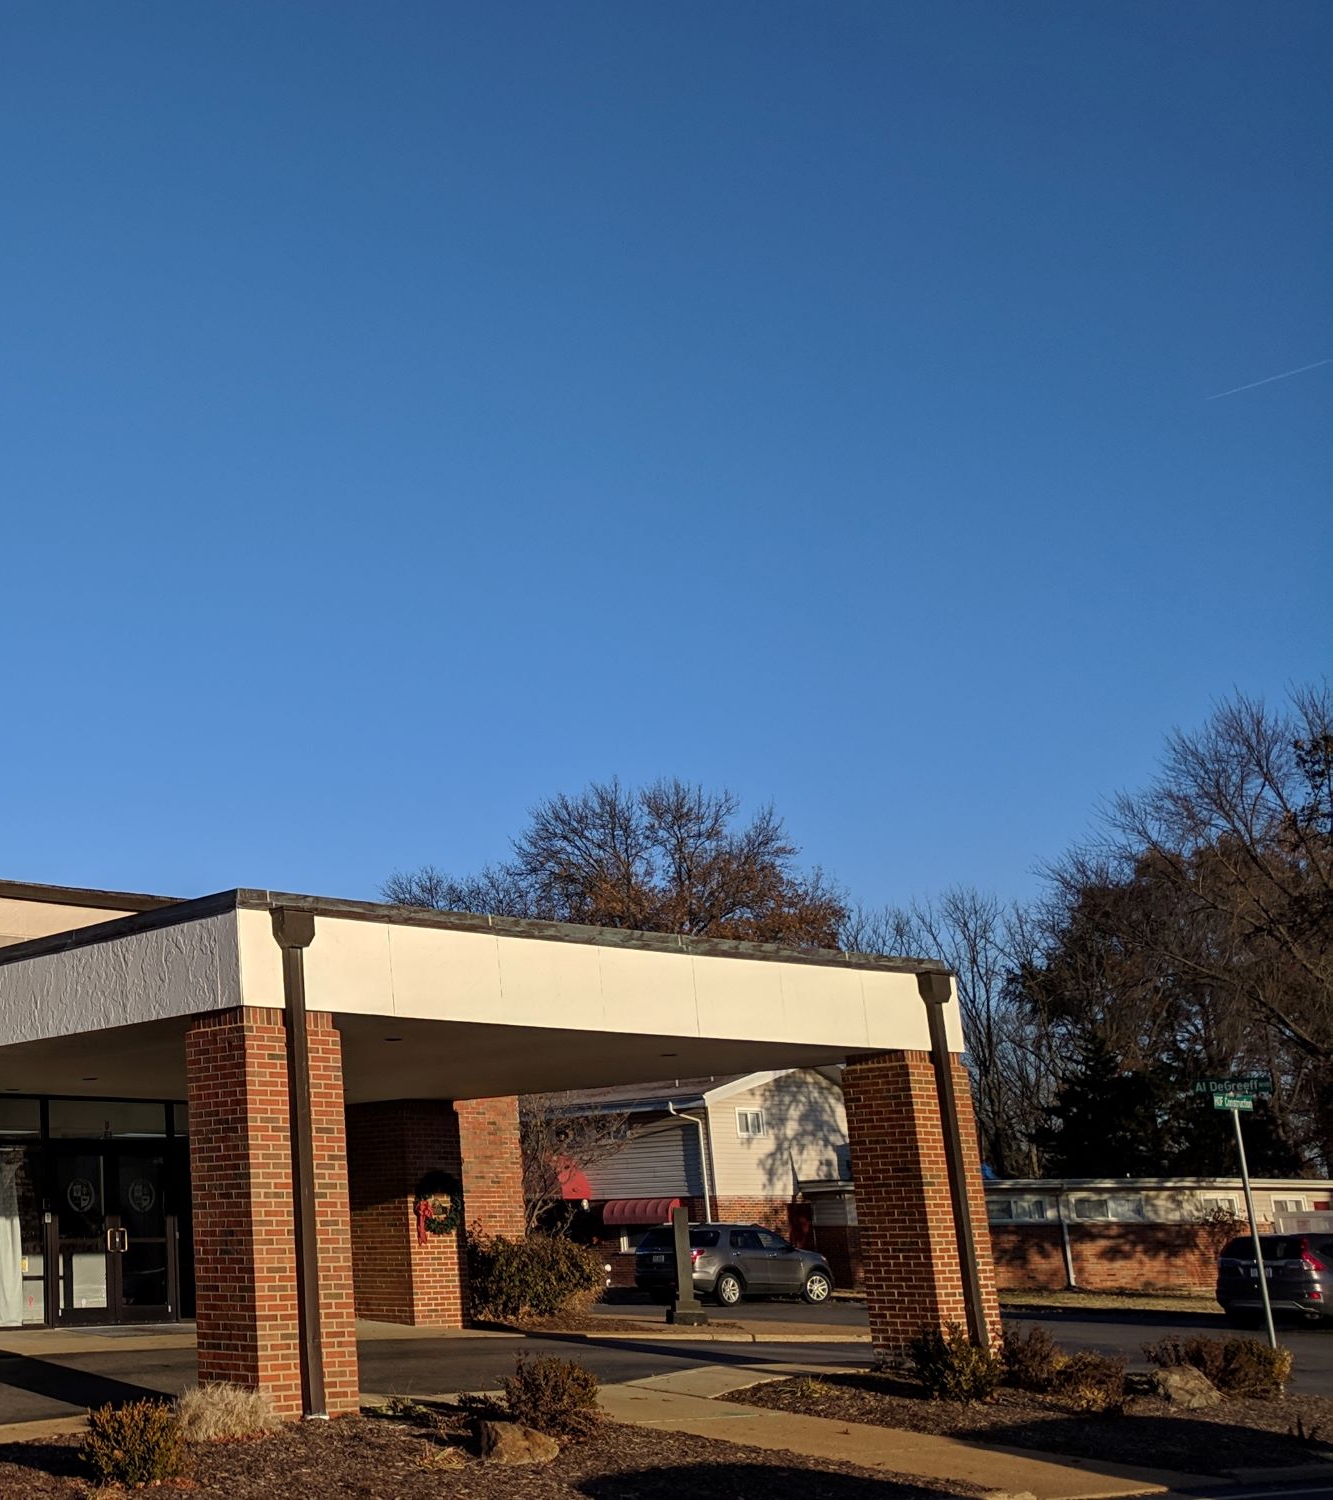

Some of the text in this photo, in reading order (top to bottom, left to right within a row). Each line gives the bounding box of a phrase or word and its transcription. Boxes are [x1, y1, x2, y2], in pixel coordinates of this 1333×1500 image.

[1195, 1081, 1206, 1092] Al
[1209, 1079, 1259, 1092] DeGreeff
[1224, 1097, 1253, 1109] Construction
